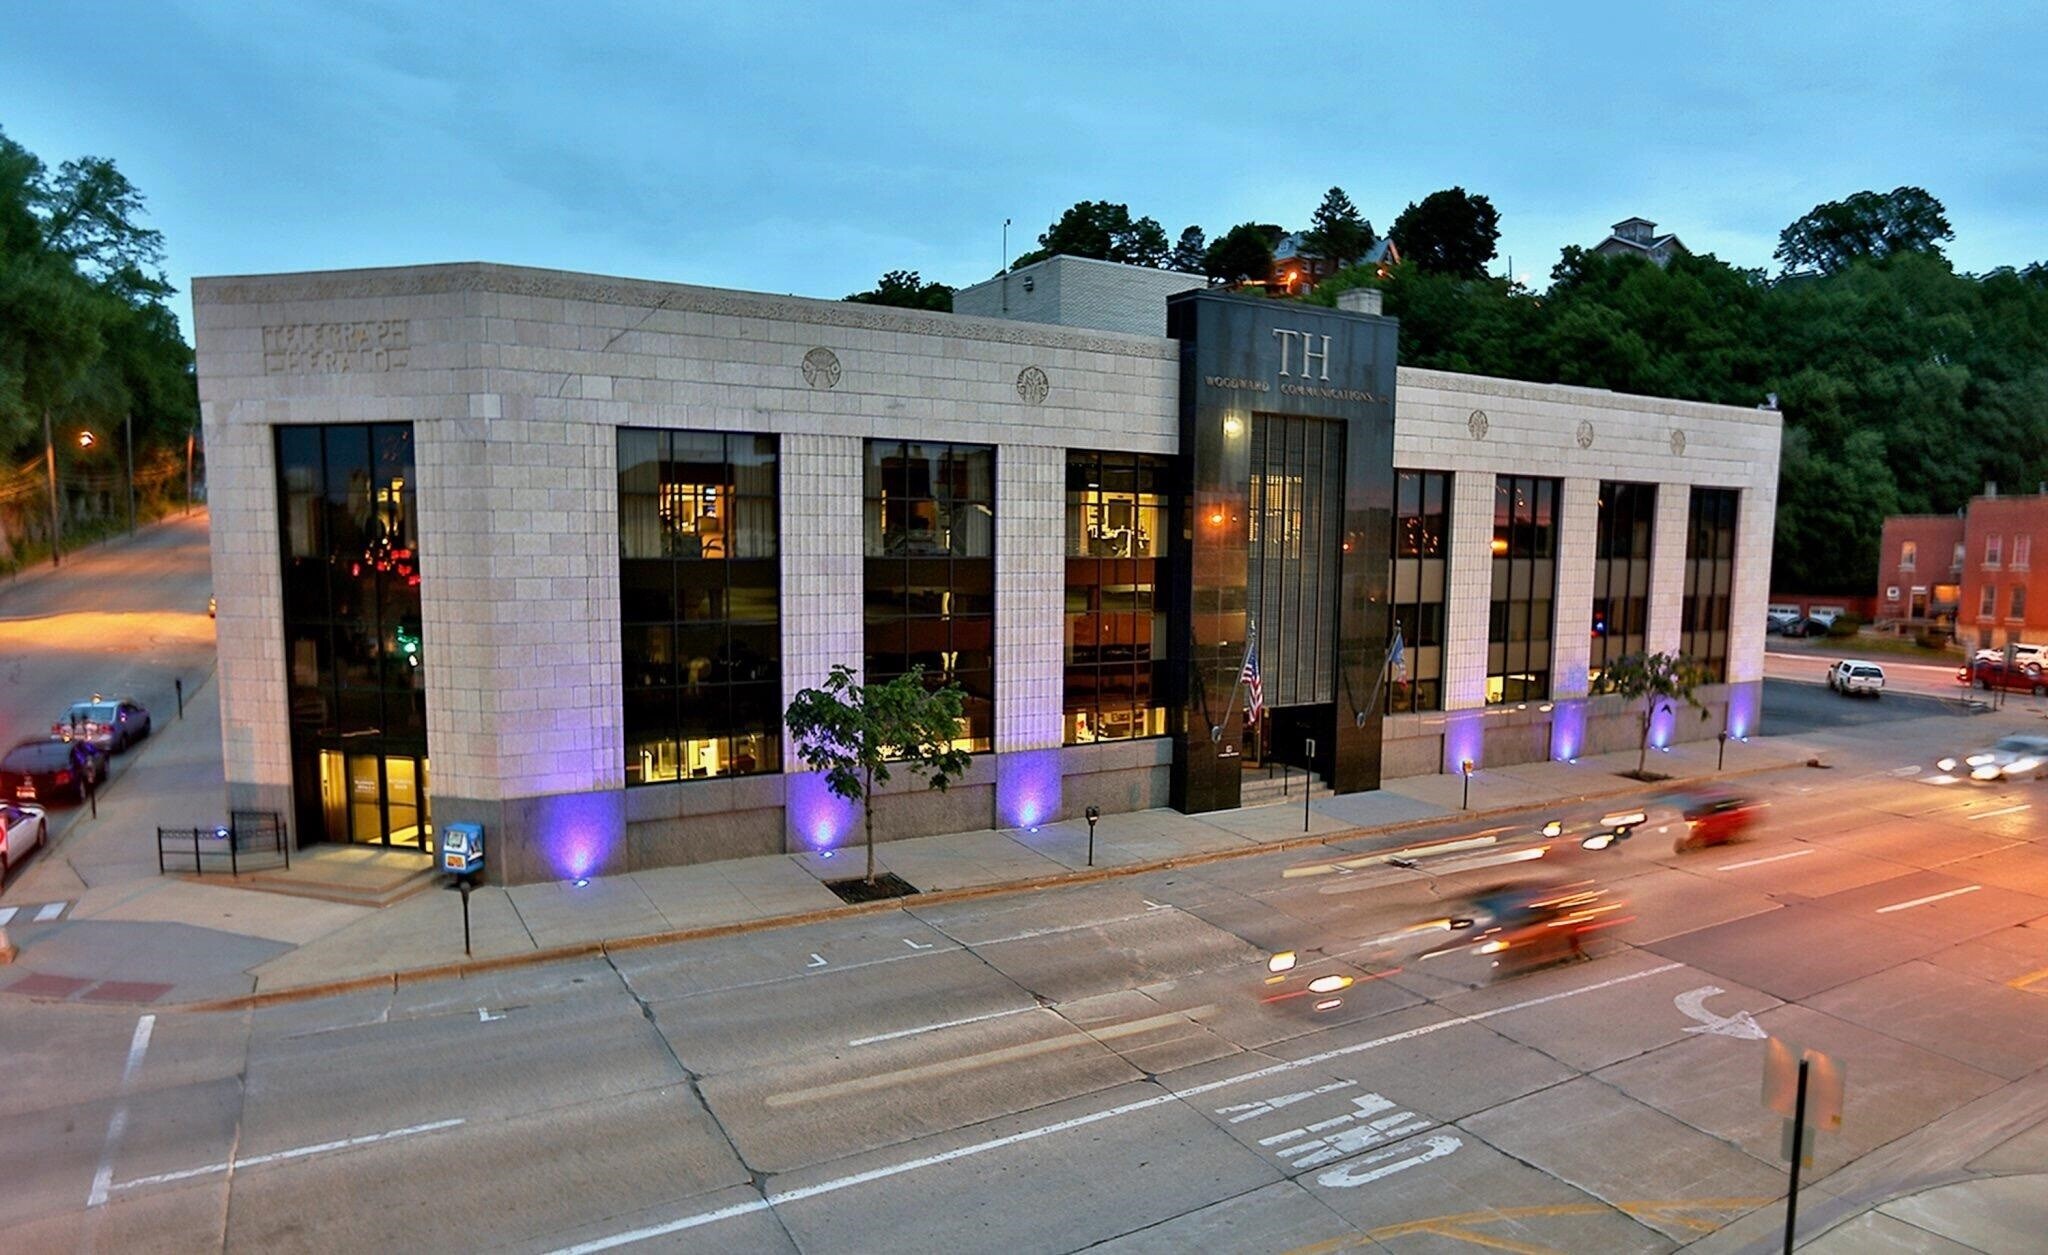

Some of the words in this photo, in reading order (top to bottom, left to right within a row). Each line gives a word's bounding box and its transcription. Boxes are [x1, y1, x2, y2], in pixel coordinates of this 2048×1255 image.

[1272, 328, 1332, 381] TH
[1205, 375, 1271, 393] WOODWARD
[1214, 1079, 1463, 1187] ONLY
